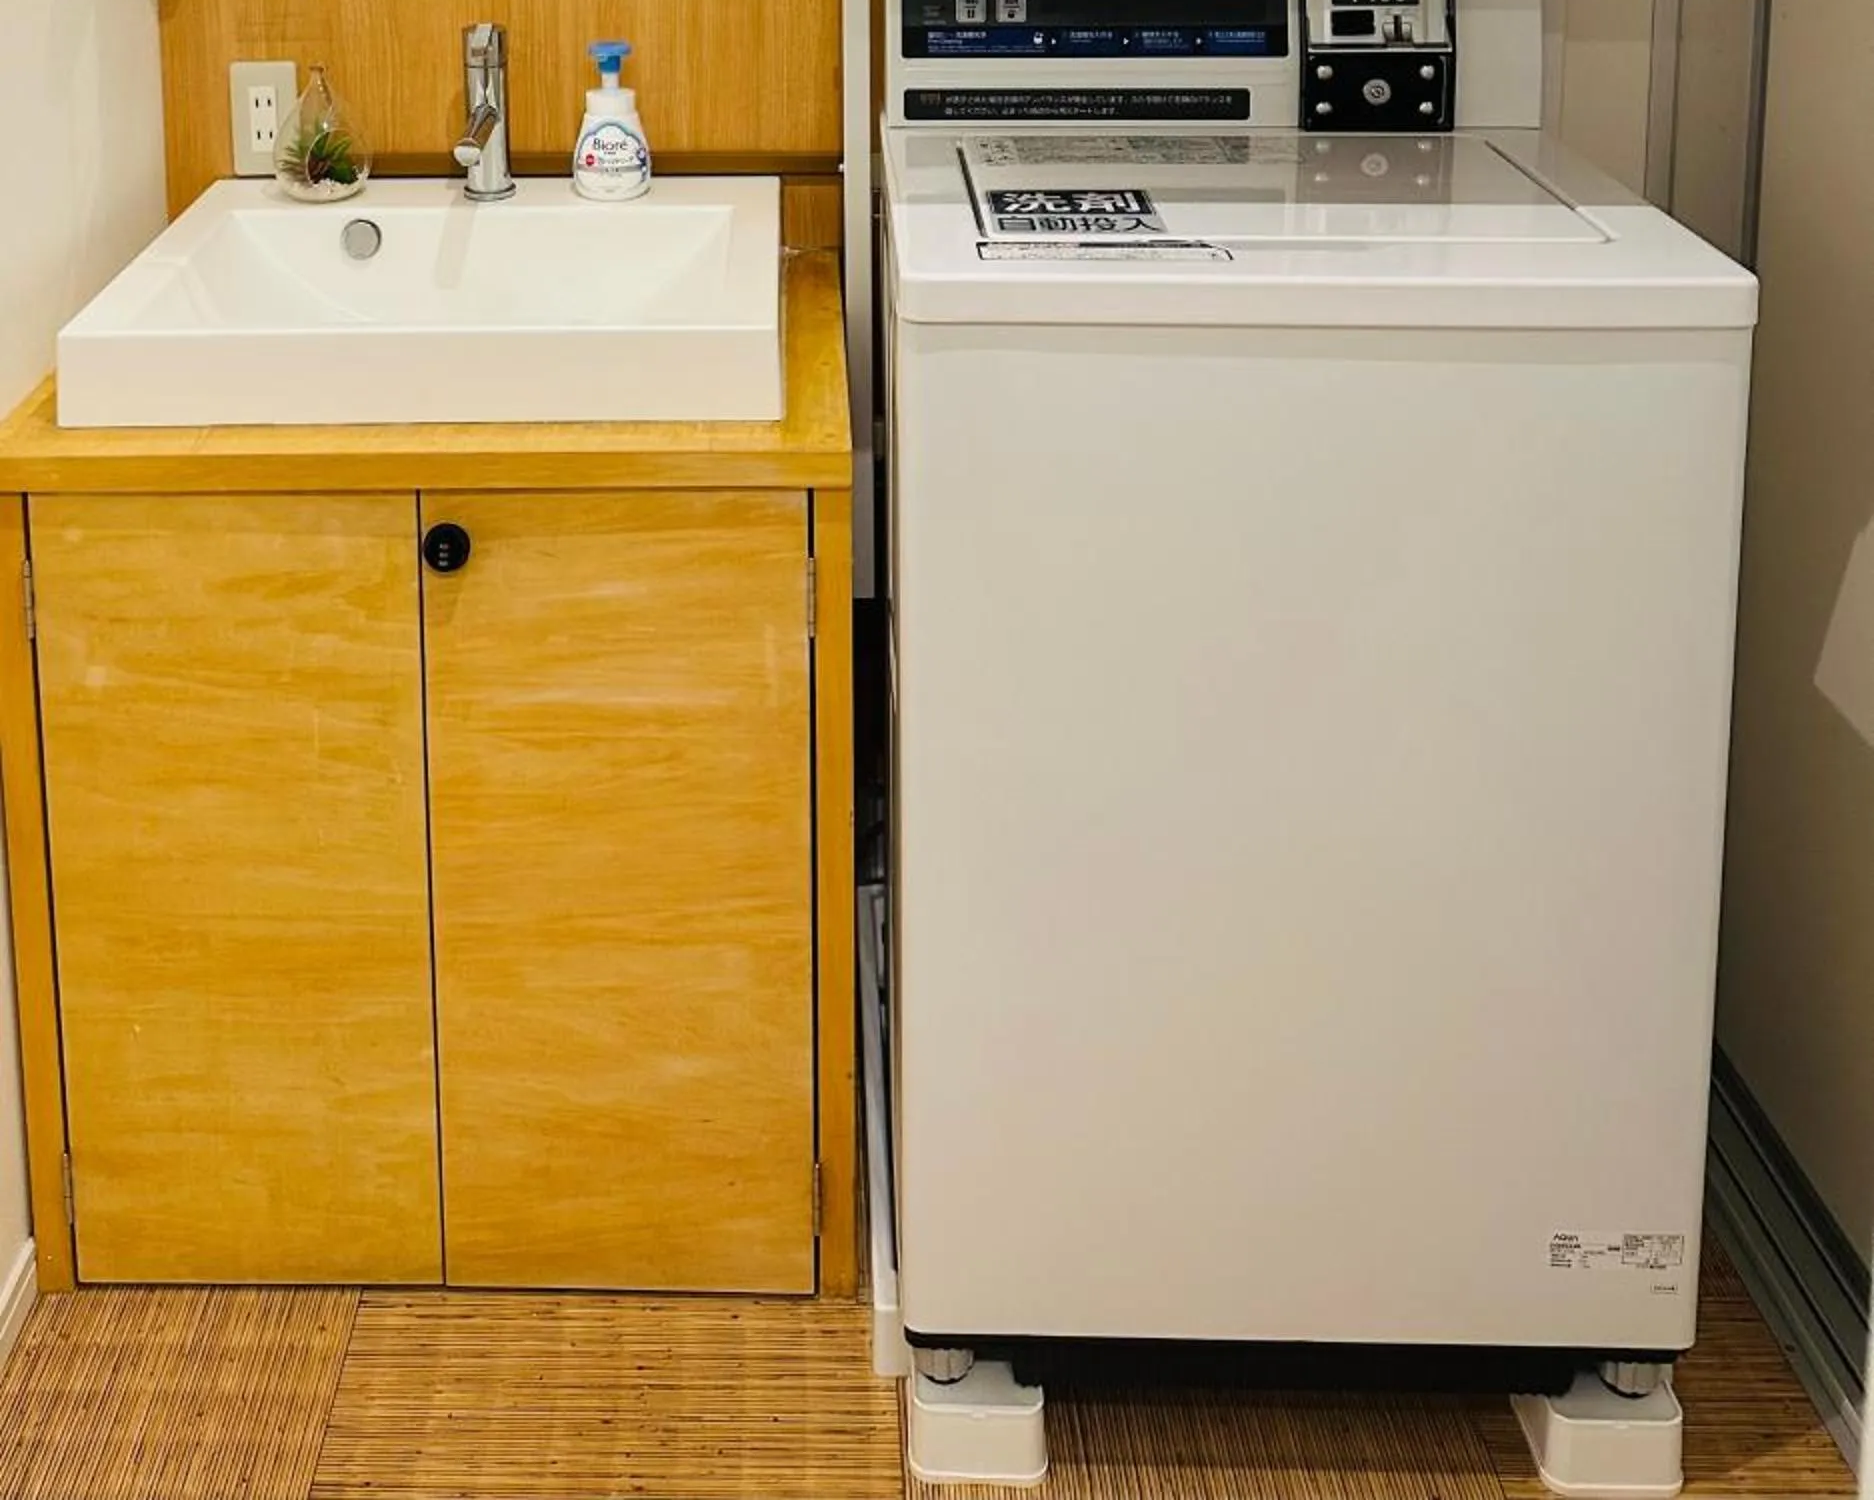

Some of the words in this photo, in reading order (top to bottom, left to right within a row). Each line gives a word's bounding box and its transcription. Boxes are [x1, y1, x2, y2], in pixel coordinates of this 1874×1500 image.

[593, 137, 628, 151] Bioré
[1002, 191, 1142, 212] 洗剤
[997, 216, 1160, 232] 自動投入
